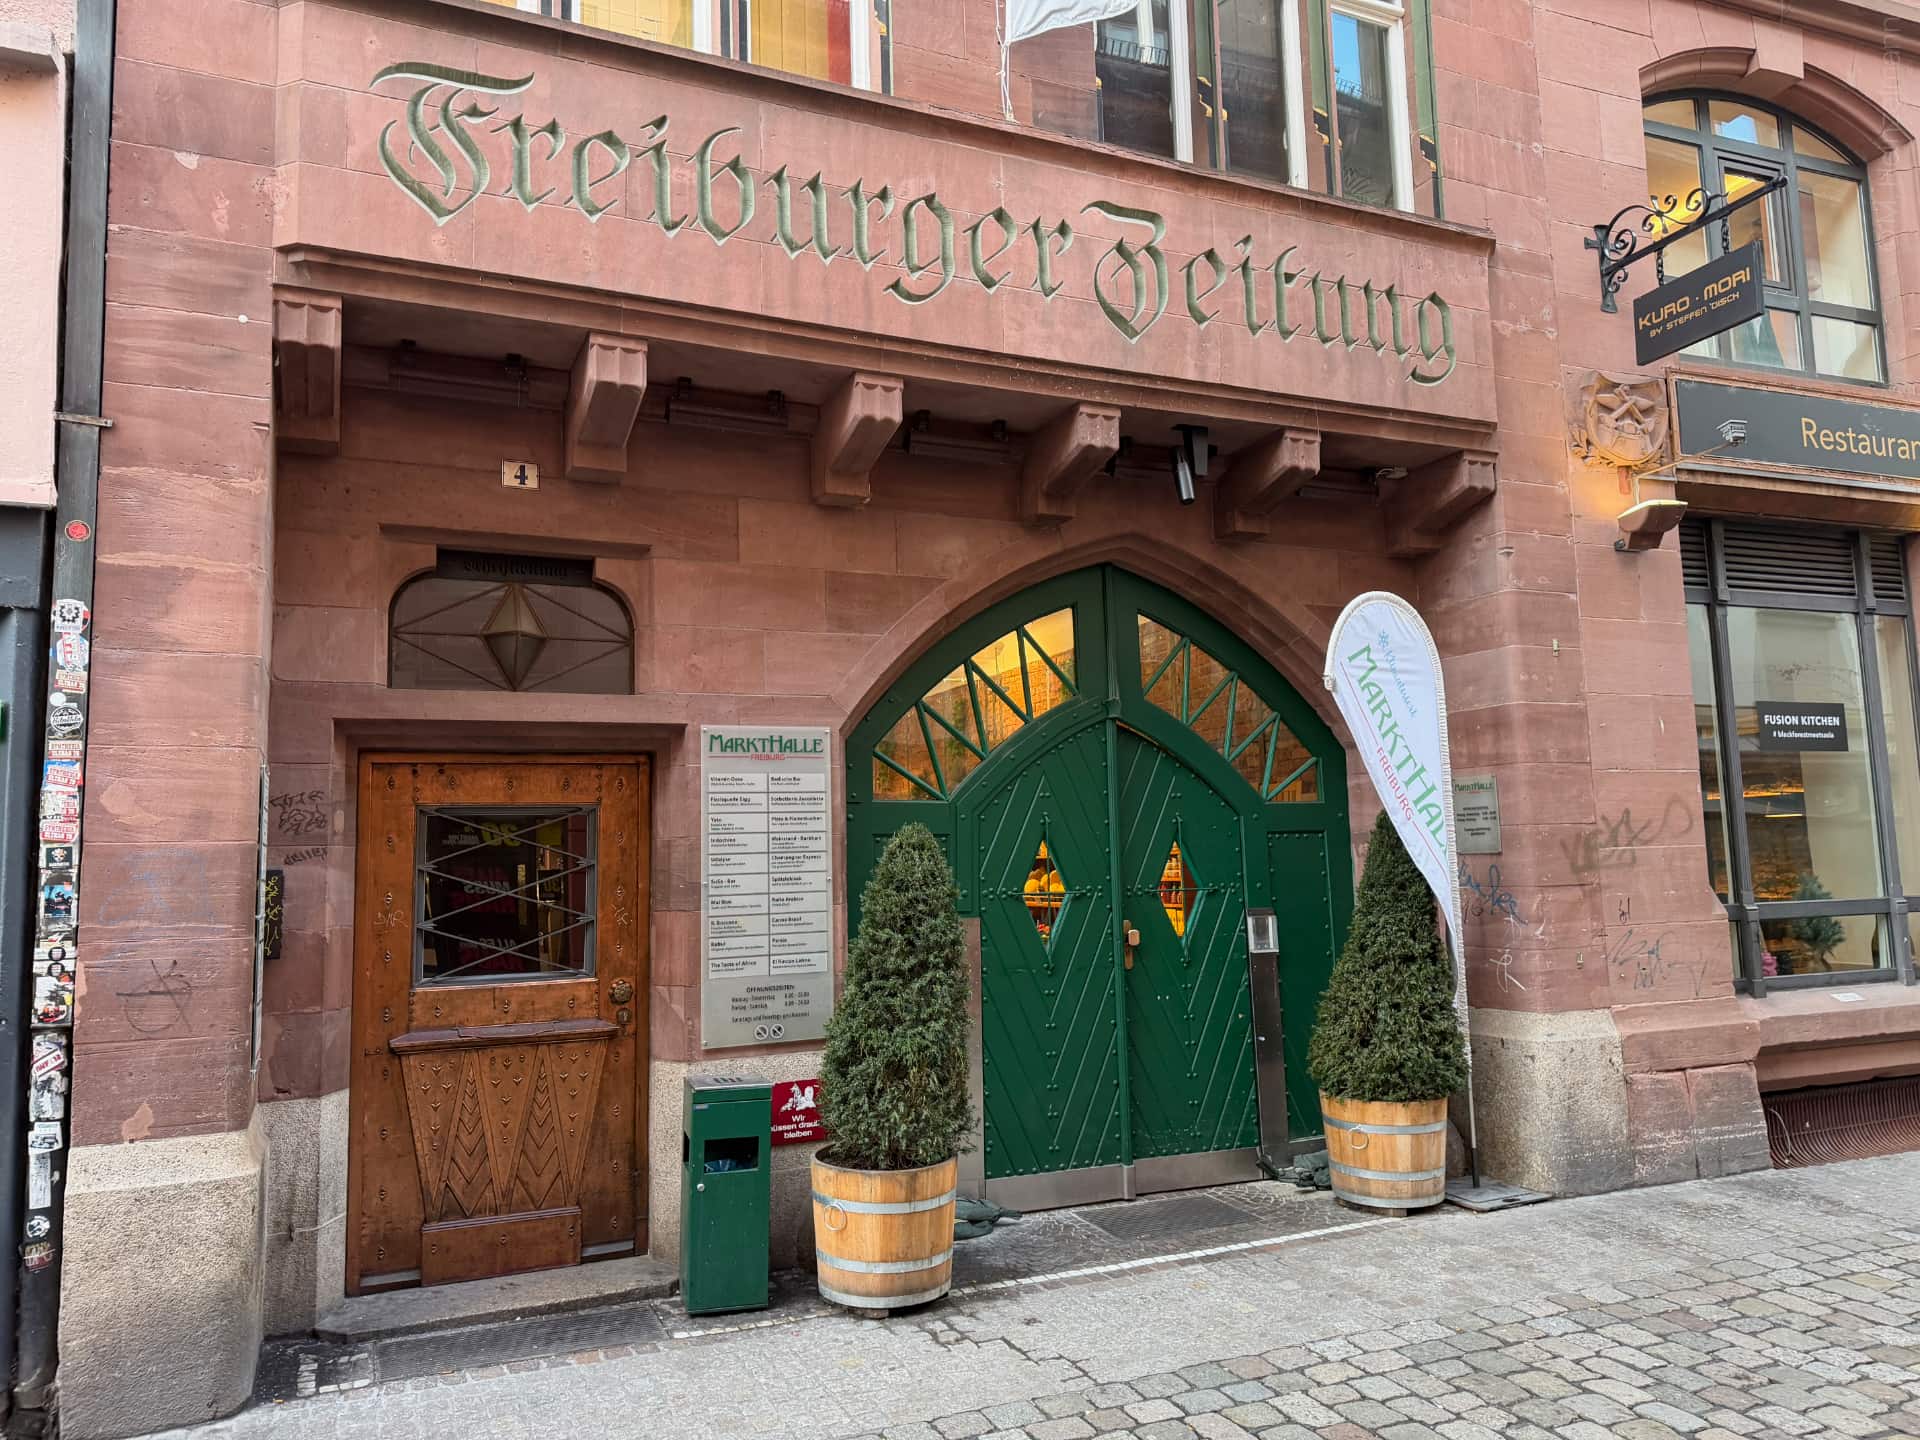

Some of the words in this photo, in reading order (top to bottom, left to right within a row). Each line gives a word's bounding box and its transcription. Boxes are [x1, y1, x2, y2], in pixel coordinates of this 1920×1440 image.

[369, 62, 1073, 304] Freiburger
[1080, 200, 1456, 386] Zeitung
[1638, 296, 1690, 330] KURO
[1703, 267, 1751, 301] MORI
[1649, 326, 1663, 338] BY
[1666, 306, 1708, 330] STEFFEN
[513, 463, 529, 486] 4
[1764, 714, 1799, 726] FUSION
[1801, 715, 1840, 727] KITCHEN
[709, 734, 825, 753] MARKTHALLE
[751, 753, 785, 761] FREIBURG
[1376, 747, 1415, 822] FREIBURG
[791, 1114, 806, 1122] Wir
[784, 1130, 813, 1139] bleiben
